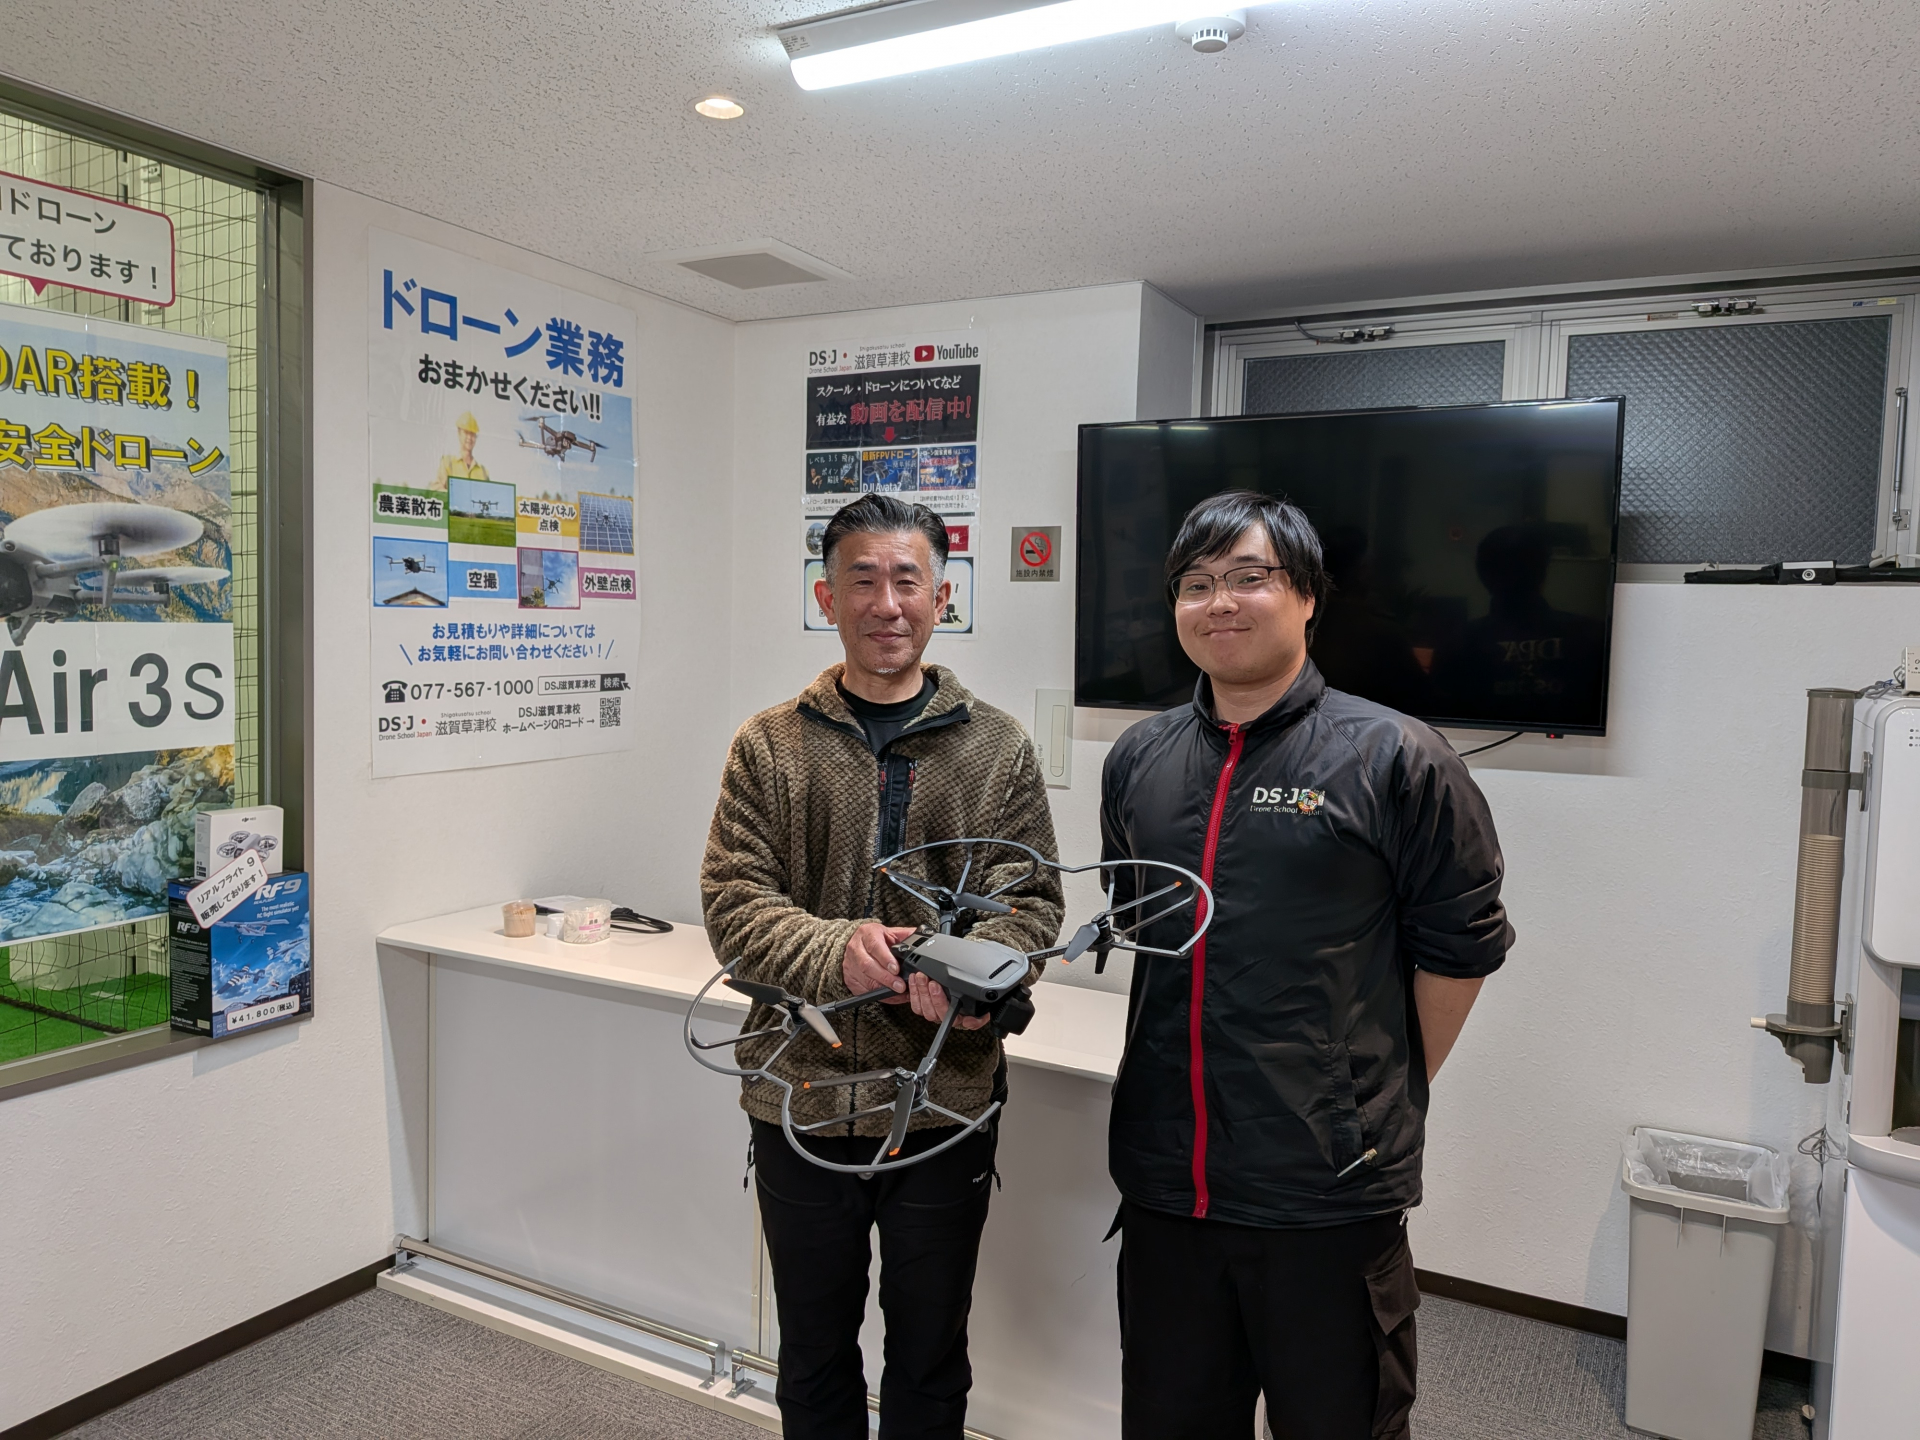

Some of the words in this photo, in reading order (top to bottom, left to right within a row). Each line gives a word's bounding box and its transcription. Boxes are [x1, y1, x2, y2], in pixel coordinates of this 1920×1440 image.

[383, 268, 625, 388] ドローン業務
[854, 350, 911, 370] 滋賀草津校
[937, 342, 979, 361] YouTube
[838, 364, 853, 372] Japan
[816, 375, 961, 397] スクール・ドローンについてなど
[816, 412, 847, 427] 有益な
[862, 450, 918, 461] 最新FPVドローン
[862, 482, 875, 493] DJI
[378, 494, 443, 518] 農薬散布
[519, 500, 576, 518] 太陽光パネル
[538, 518, 560, 533] 点検
[467, 571, 499, 590] 空撮
[1015, 569, 1054, 578] 施設内禁煙
[584, 574, 633, 593] 外壁点検
[432, 623, 596, 640] お見積もりや詳細については
[0, 650, 108, 735] Air
[410, 680, 534, 700] 077-567-1000
[604, 677, 620, 689] 検索
[378, 733, 396, 741] Drone
[397, 731, 416, 740] School
[416, 730, 433, 738] Japan
[434, 716, 497, 736] 滋賀草津校
[197, 866, 245, 905] リアルフライト
[246, 856, 255, 868] 9
[254, 878, 302, 901] RF9
[177, 921, 201, 934] RF9
